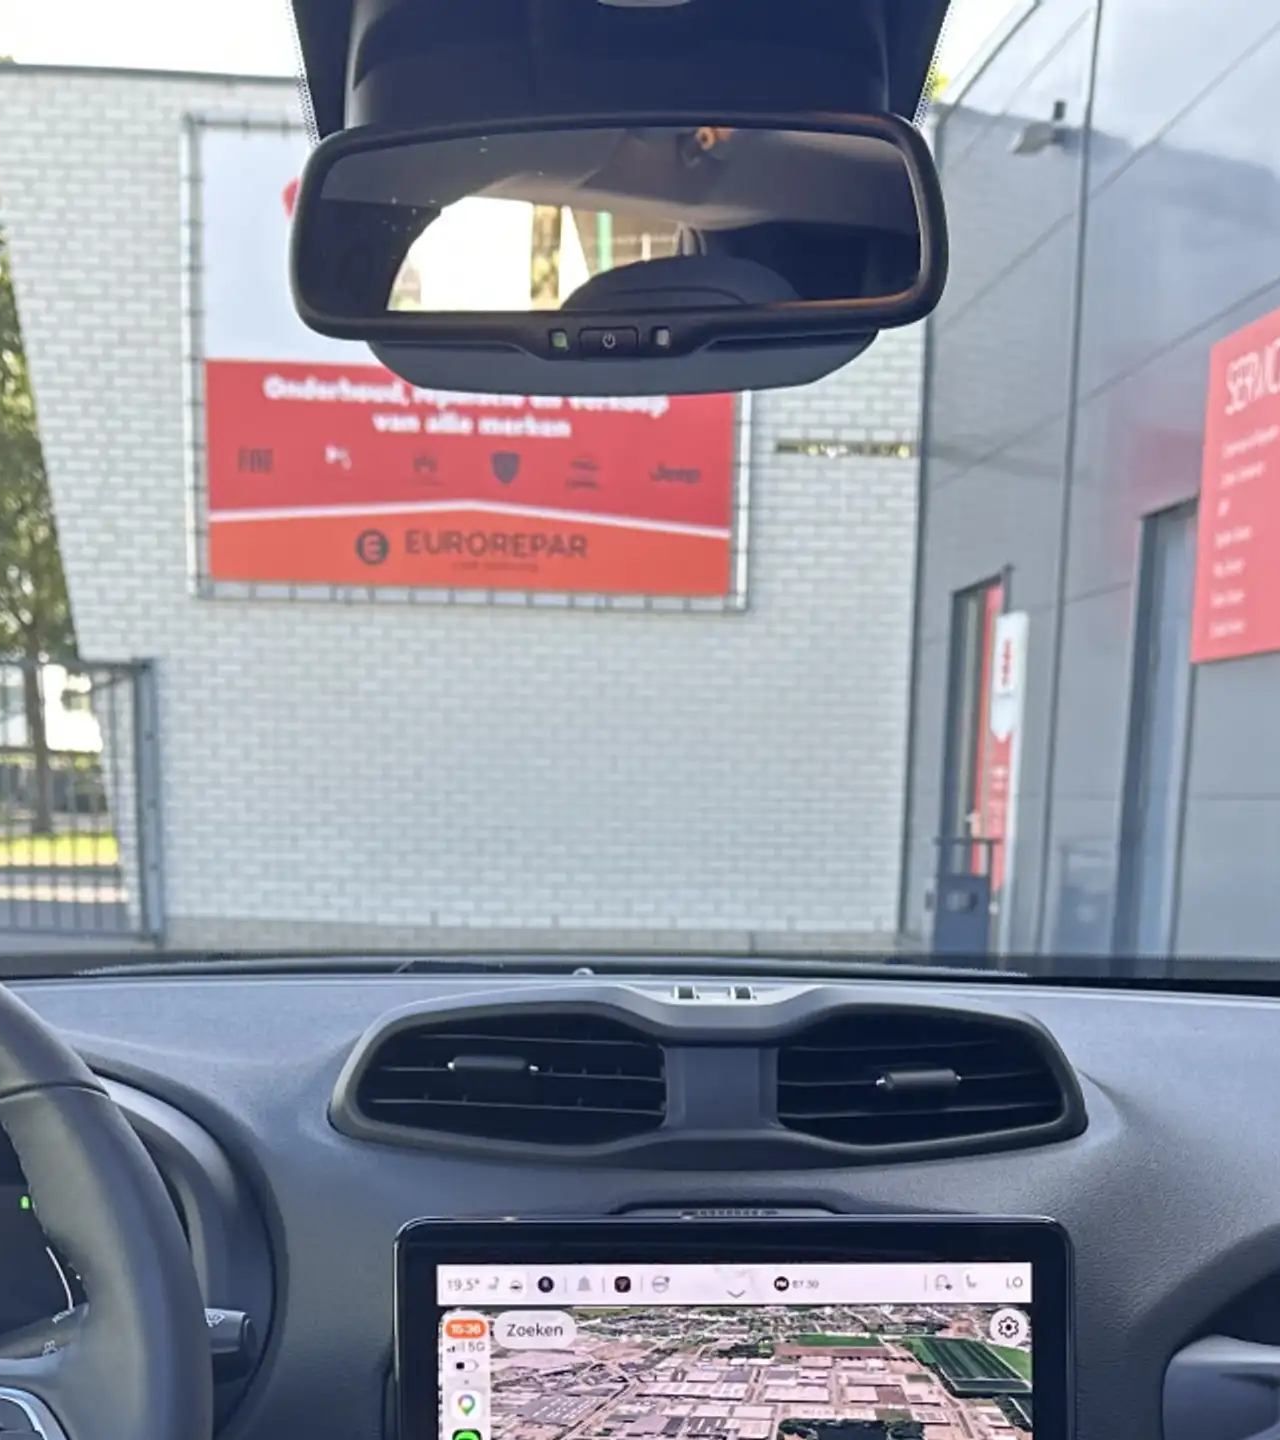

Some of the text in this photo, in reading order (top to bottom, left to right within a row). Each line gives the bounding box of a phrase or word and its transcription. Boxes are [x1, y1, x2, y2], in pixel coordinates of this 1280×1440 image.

[372, 411, 572, 438] van alle merken
[404, 529, 589, 560] EUROREPAR
[506, 1323, 564, 1337] Zoeken
[468, 1340, 486, 1353] 5G
